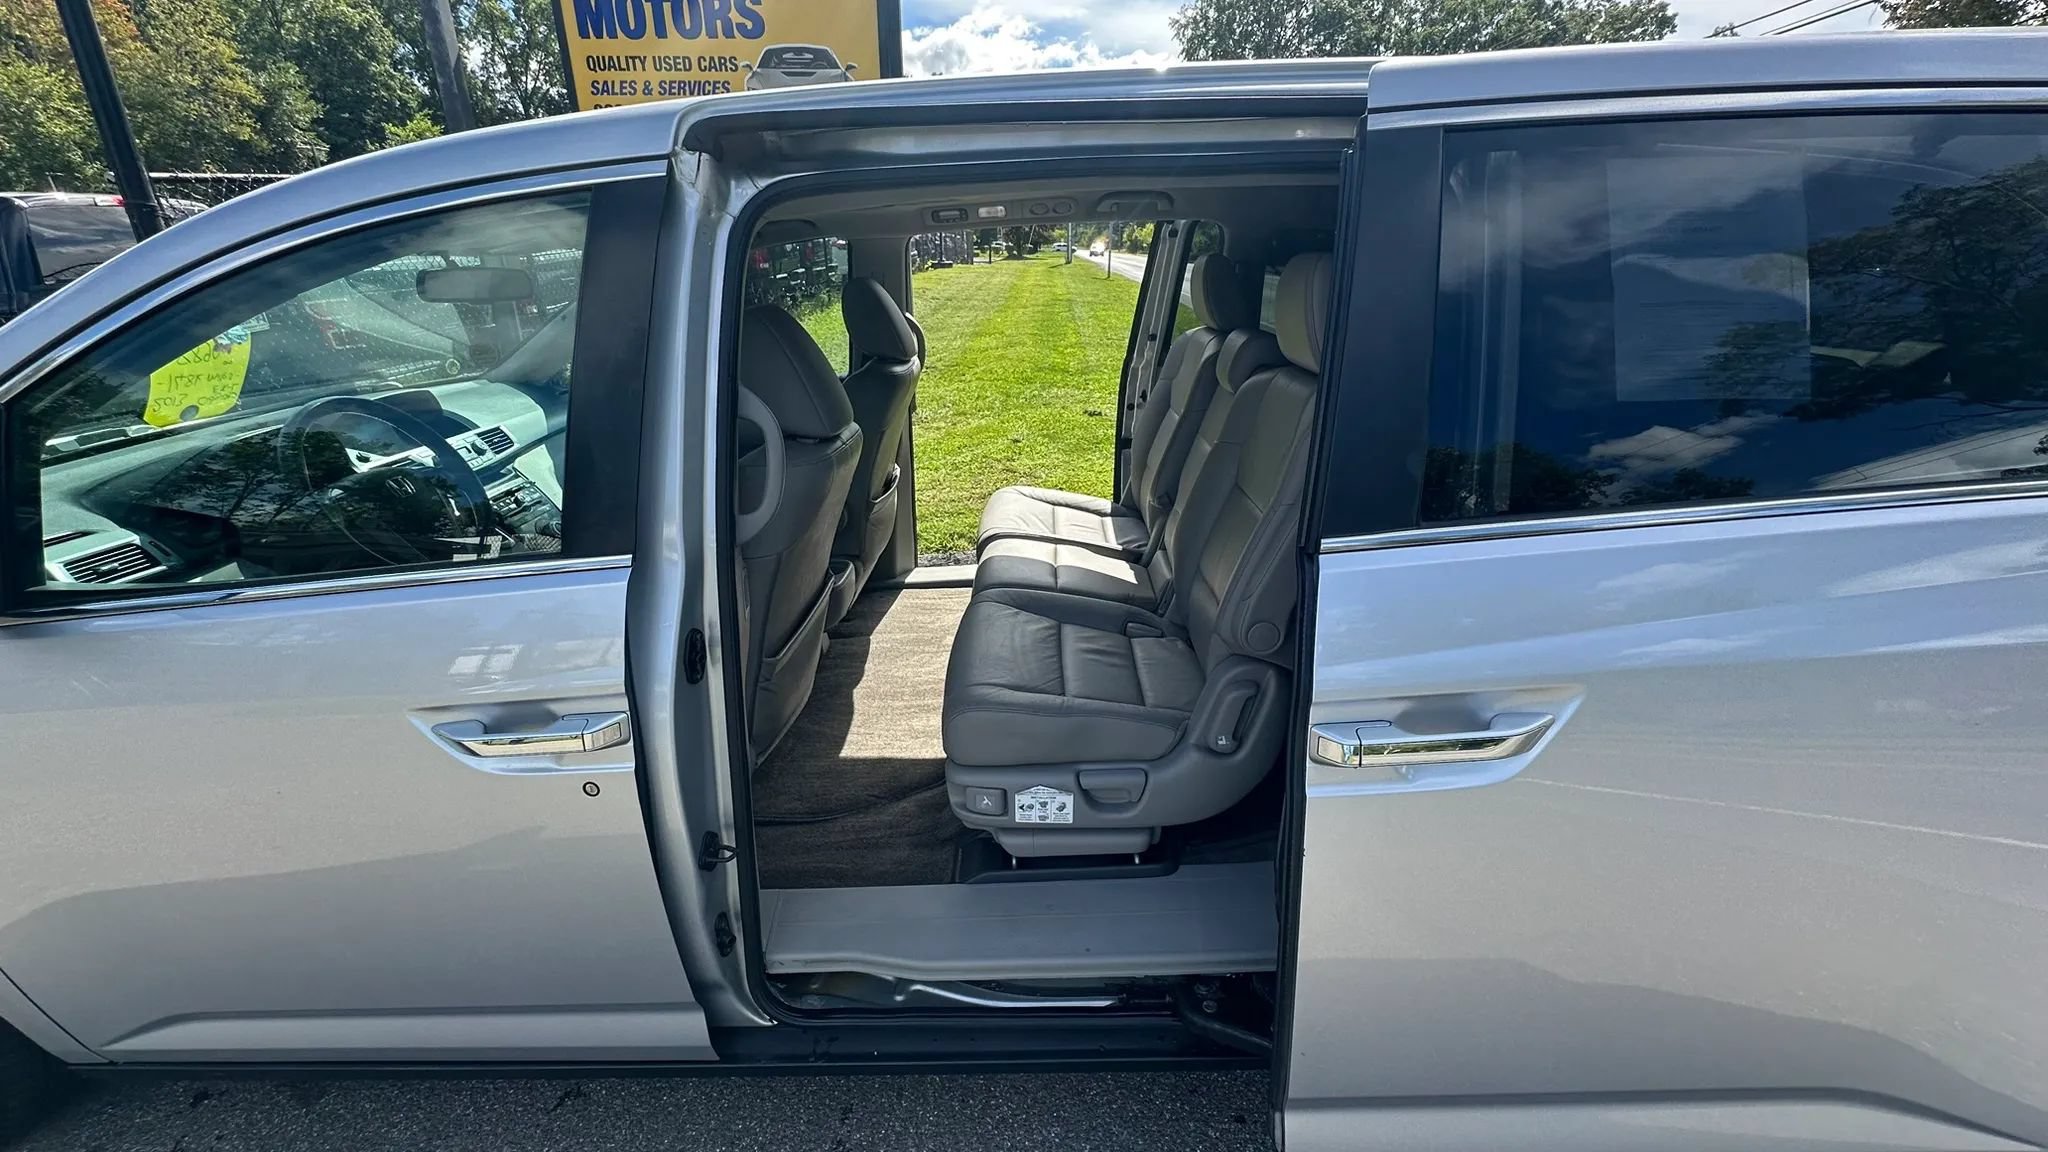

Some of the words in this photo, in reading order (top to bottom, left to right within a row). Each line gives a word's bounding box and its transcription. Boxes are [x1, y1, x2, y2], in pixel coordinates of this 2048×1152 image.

[574, 0, 765, 40] MOTORS
[586, 55, 647, 73] QUALITY
[653, 56, 692, 72] USED
[697, 56, 739, 73] CARS
[591, 80, 637, 96] SALES
[642, 80, 653, 96] &
[658, 80, 731, 96] SERVICES
